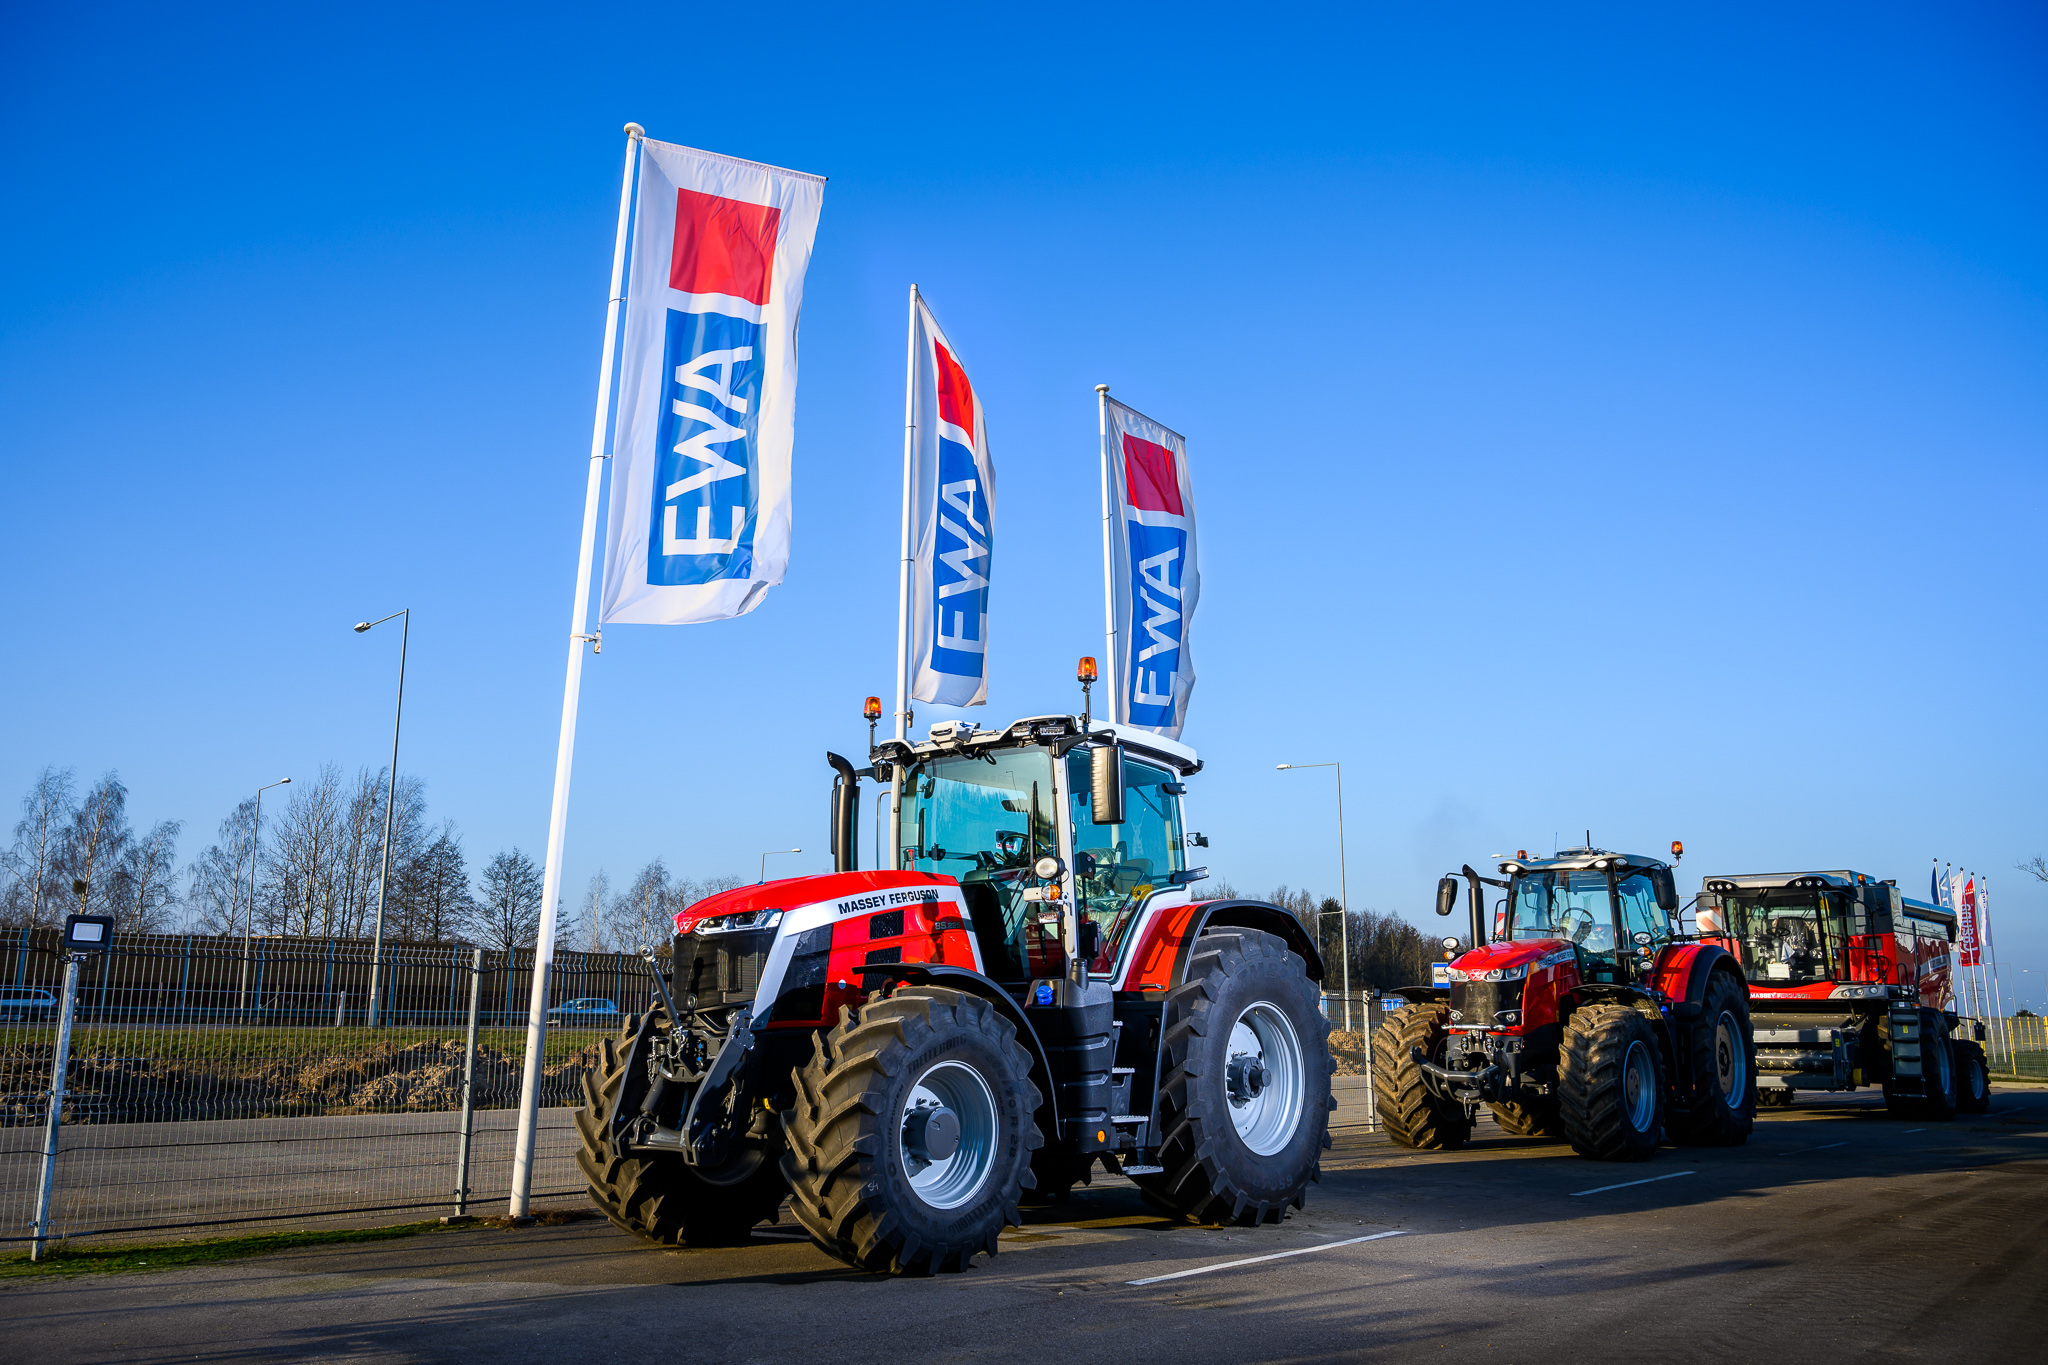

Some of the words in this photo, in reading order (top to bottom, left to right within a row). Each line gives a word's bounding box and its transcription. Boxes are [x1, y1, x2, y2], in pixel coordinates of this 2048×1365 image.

[663, 345, 753, 557] EWA
[937, 479, 990, 654] EWA
[1135, 545, 1183, 708] EWA
[838, 894, 886, 915] MASSEY
[889, 889, 940, 905] FERGUSON
[906, 1033, 967, 1075] TRELLEBORG
[947, 1191, 1005, 1236] TRELLEBORG
